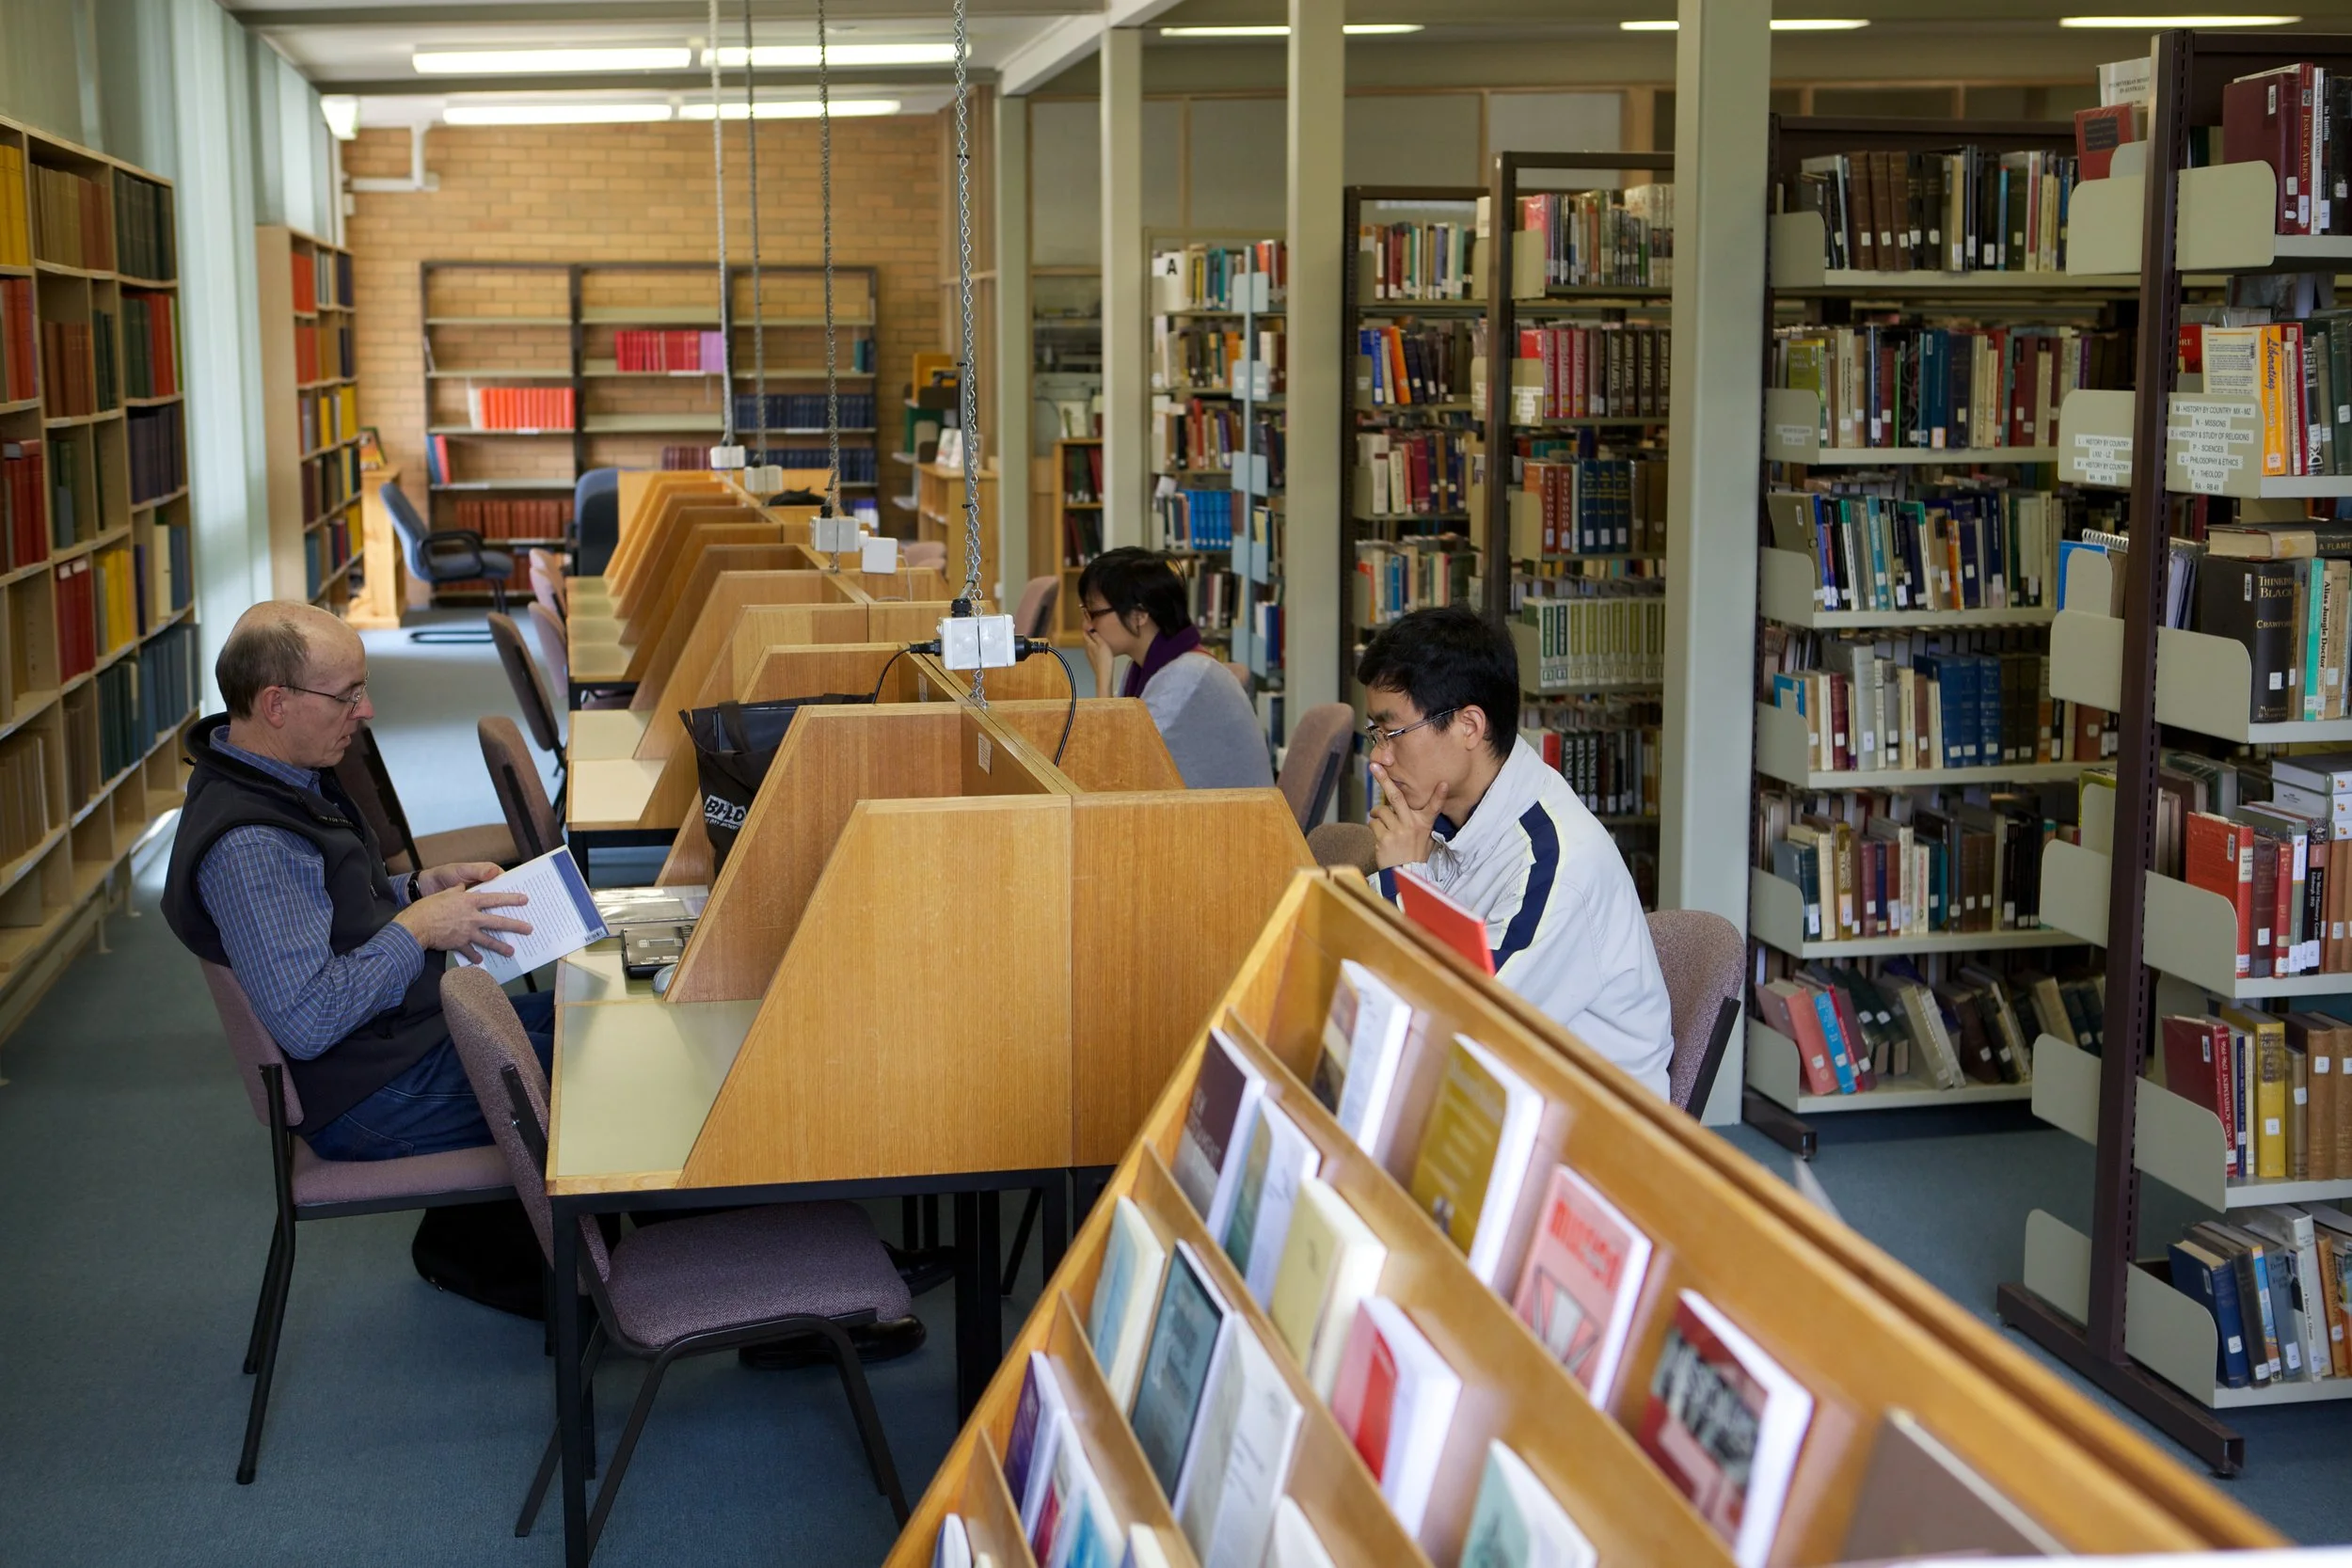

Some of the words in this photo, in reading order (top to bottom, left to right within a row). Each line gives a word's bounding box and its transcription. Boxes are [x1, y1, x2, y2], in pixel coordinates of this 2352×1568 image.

[1166, 258, 1177, 275] A
[2265, 337, 2279, 390] Liberating
[2225, 433, 2249, 441] RELIGIONS
[2190, 456, 2217, 465] PHILOSOPHY
[2222, 1073, 2231, 1120] ACHIEVEMENT
